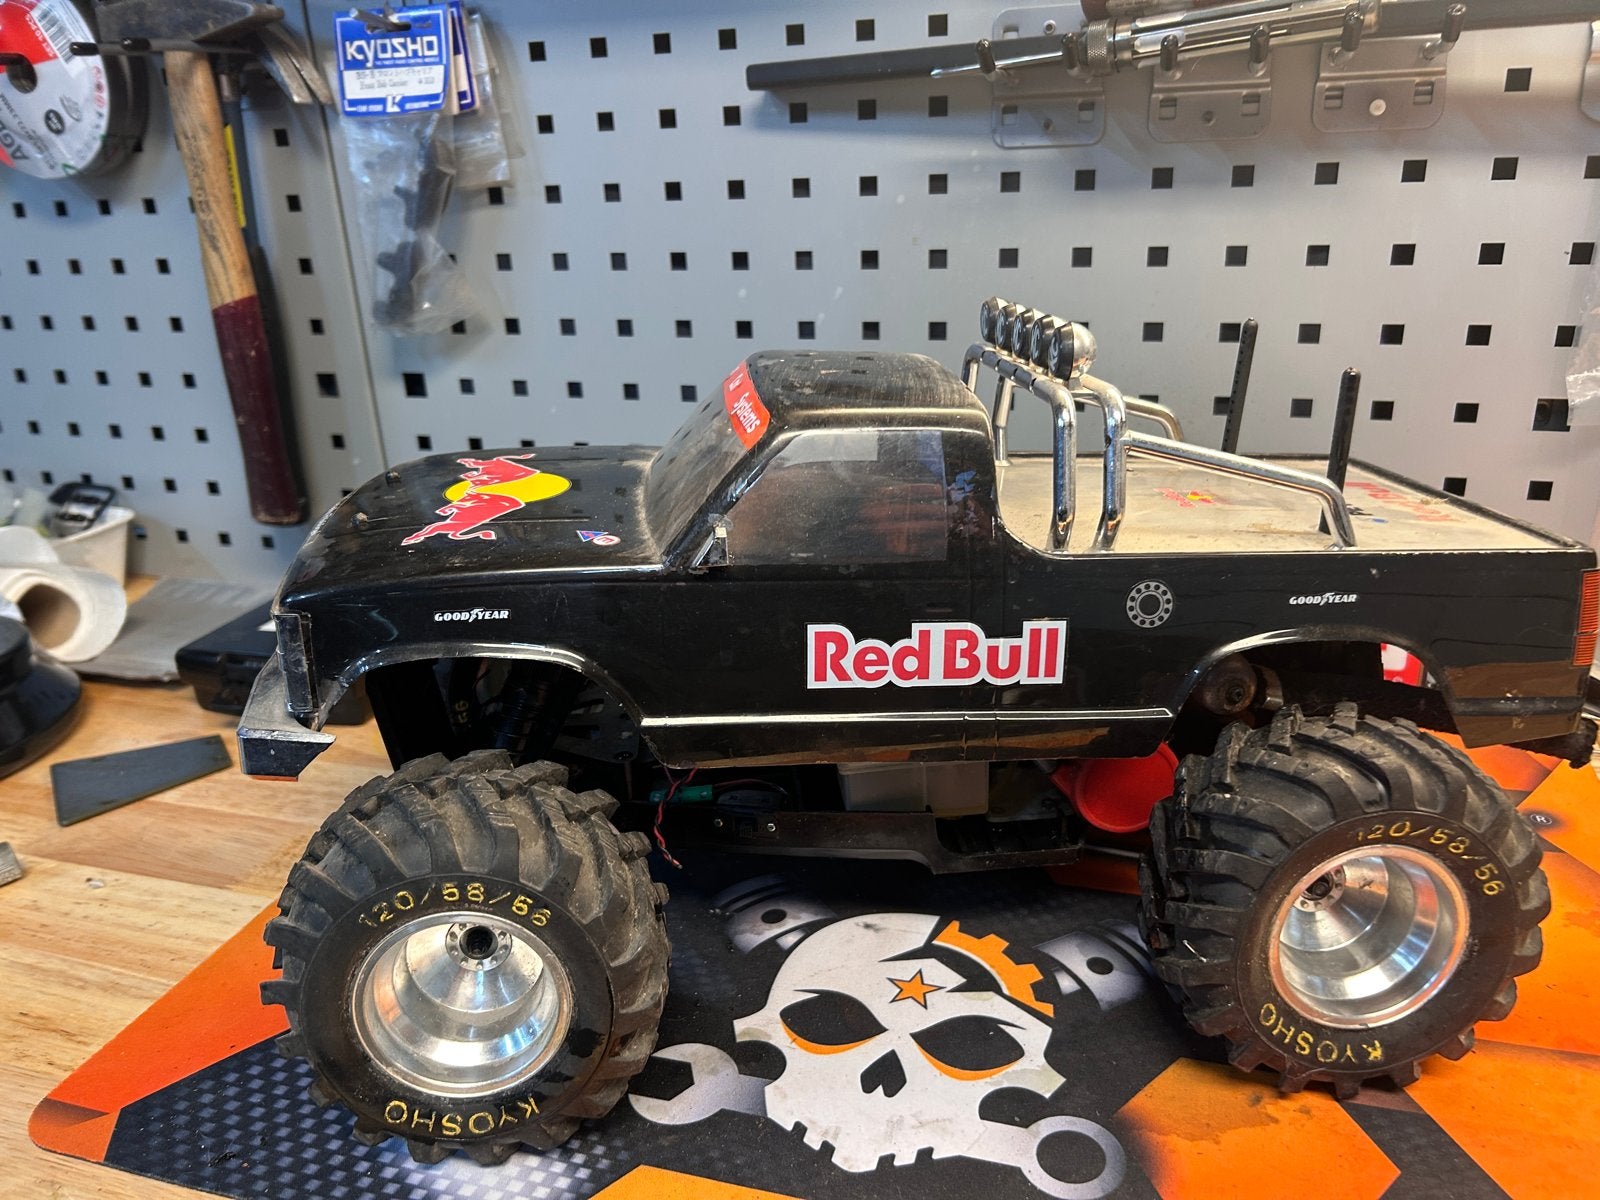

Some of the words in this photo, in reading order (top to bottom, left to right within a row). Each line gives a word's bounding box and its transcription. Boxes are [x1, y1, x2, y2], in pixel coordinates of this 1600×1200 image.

[434, 608, 509, 623] GOODYEAR
[1289, 592, 1358, 606] GOODYEAR
[813, 629, 931, 683] Red
[942, 627, 1060, 680] Bull
[1258, 1002, 1384, 1064] KYOSHO
[384, 1096, 540, 1137] KYOSHO
